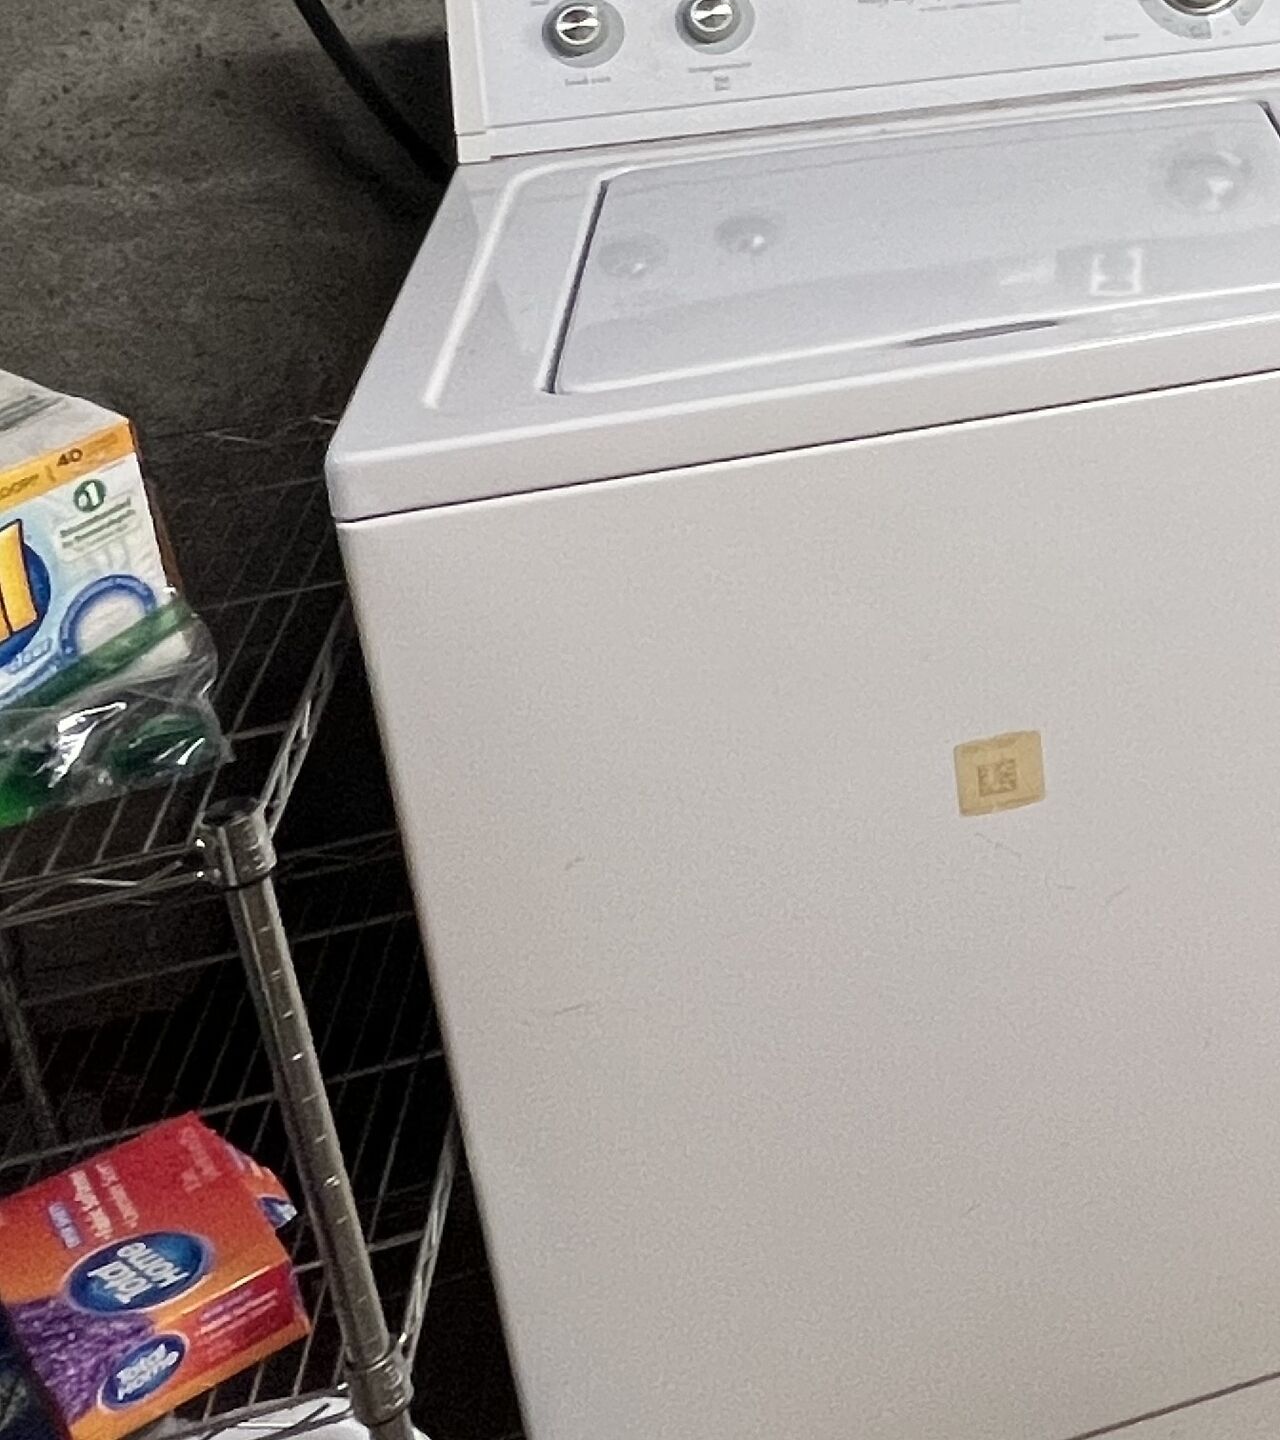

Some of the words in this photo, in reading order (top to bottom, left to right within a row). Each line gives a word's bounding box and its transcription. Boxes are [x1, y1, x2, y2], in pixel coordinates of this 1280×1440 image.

[56, 448, 84, 467] 40
[86, 1260, 153, 1305] Total
[116, 1242, 190, 1289] Home
